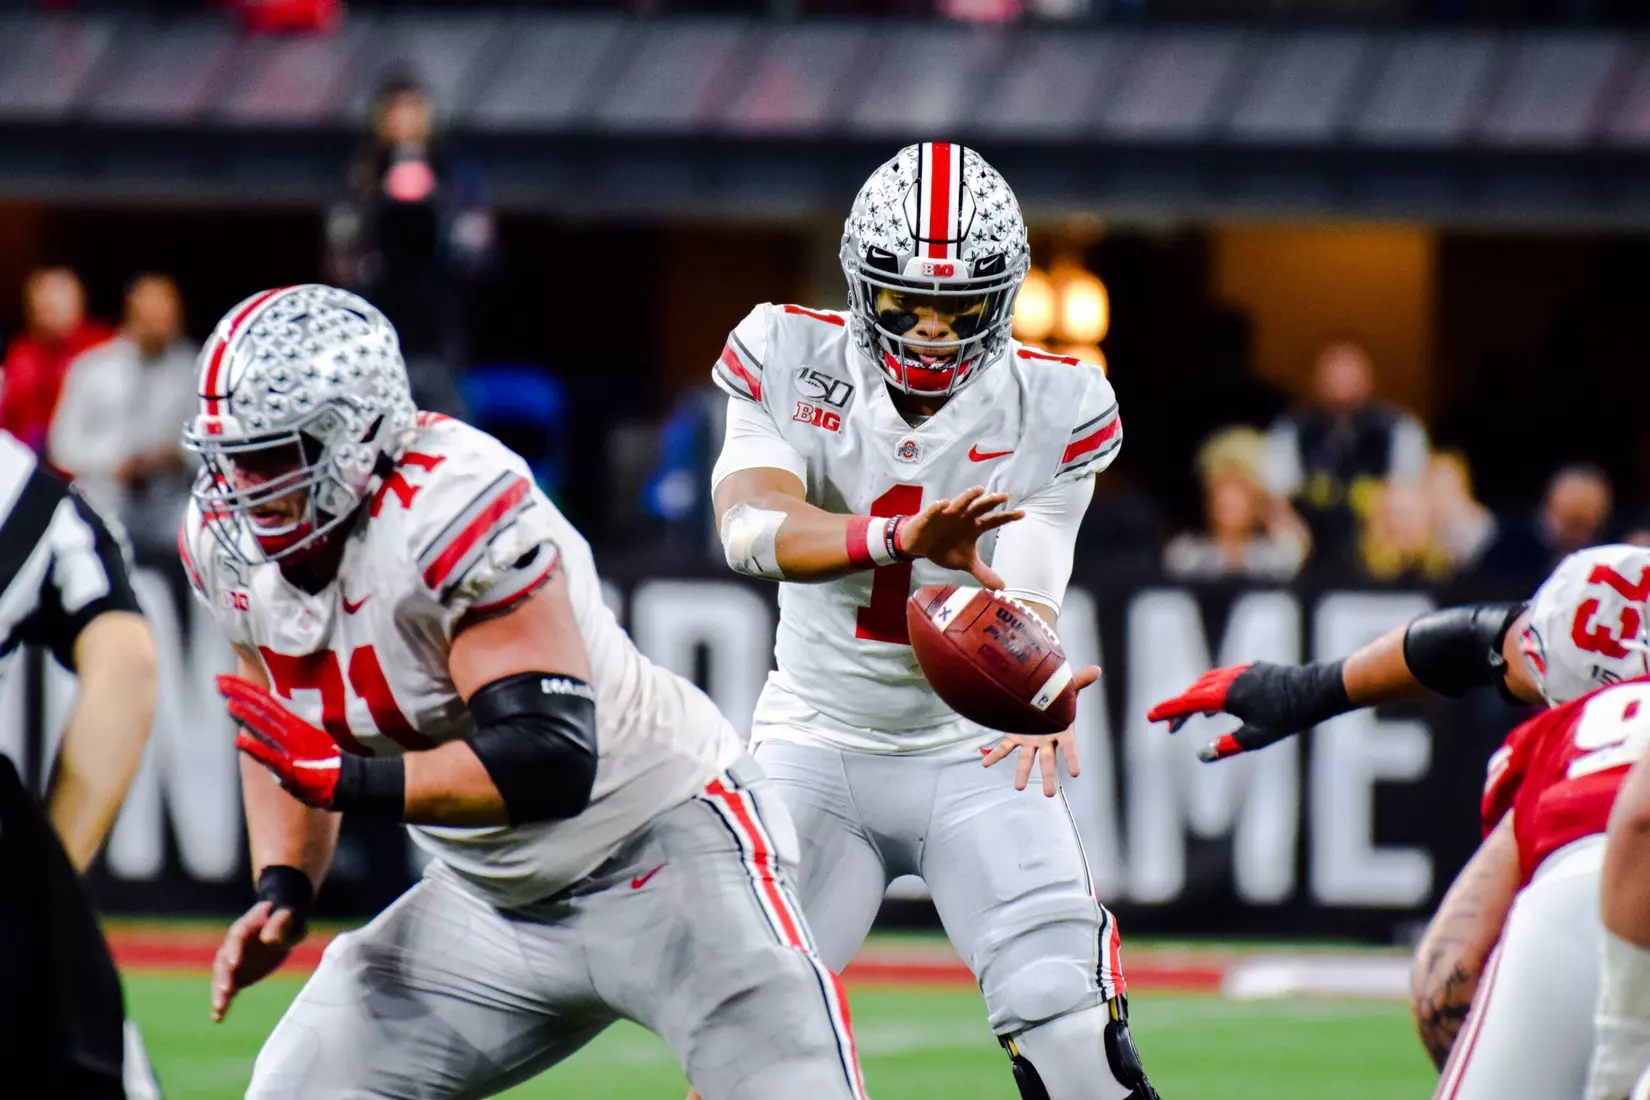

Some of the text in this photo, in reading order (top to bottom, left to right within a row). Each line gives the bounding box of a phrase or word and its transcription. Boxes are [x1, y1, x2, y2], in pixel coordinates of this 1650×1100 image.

[799, 367, 854, 408] 150
[856, 483, 923, 645] 1
[258, 644, 442, 757] 71
